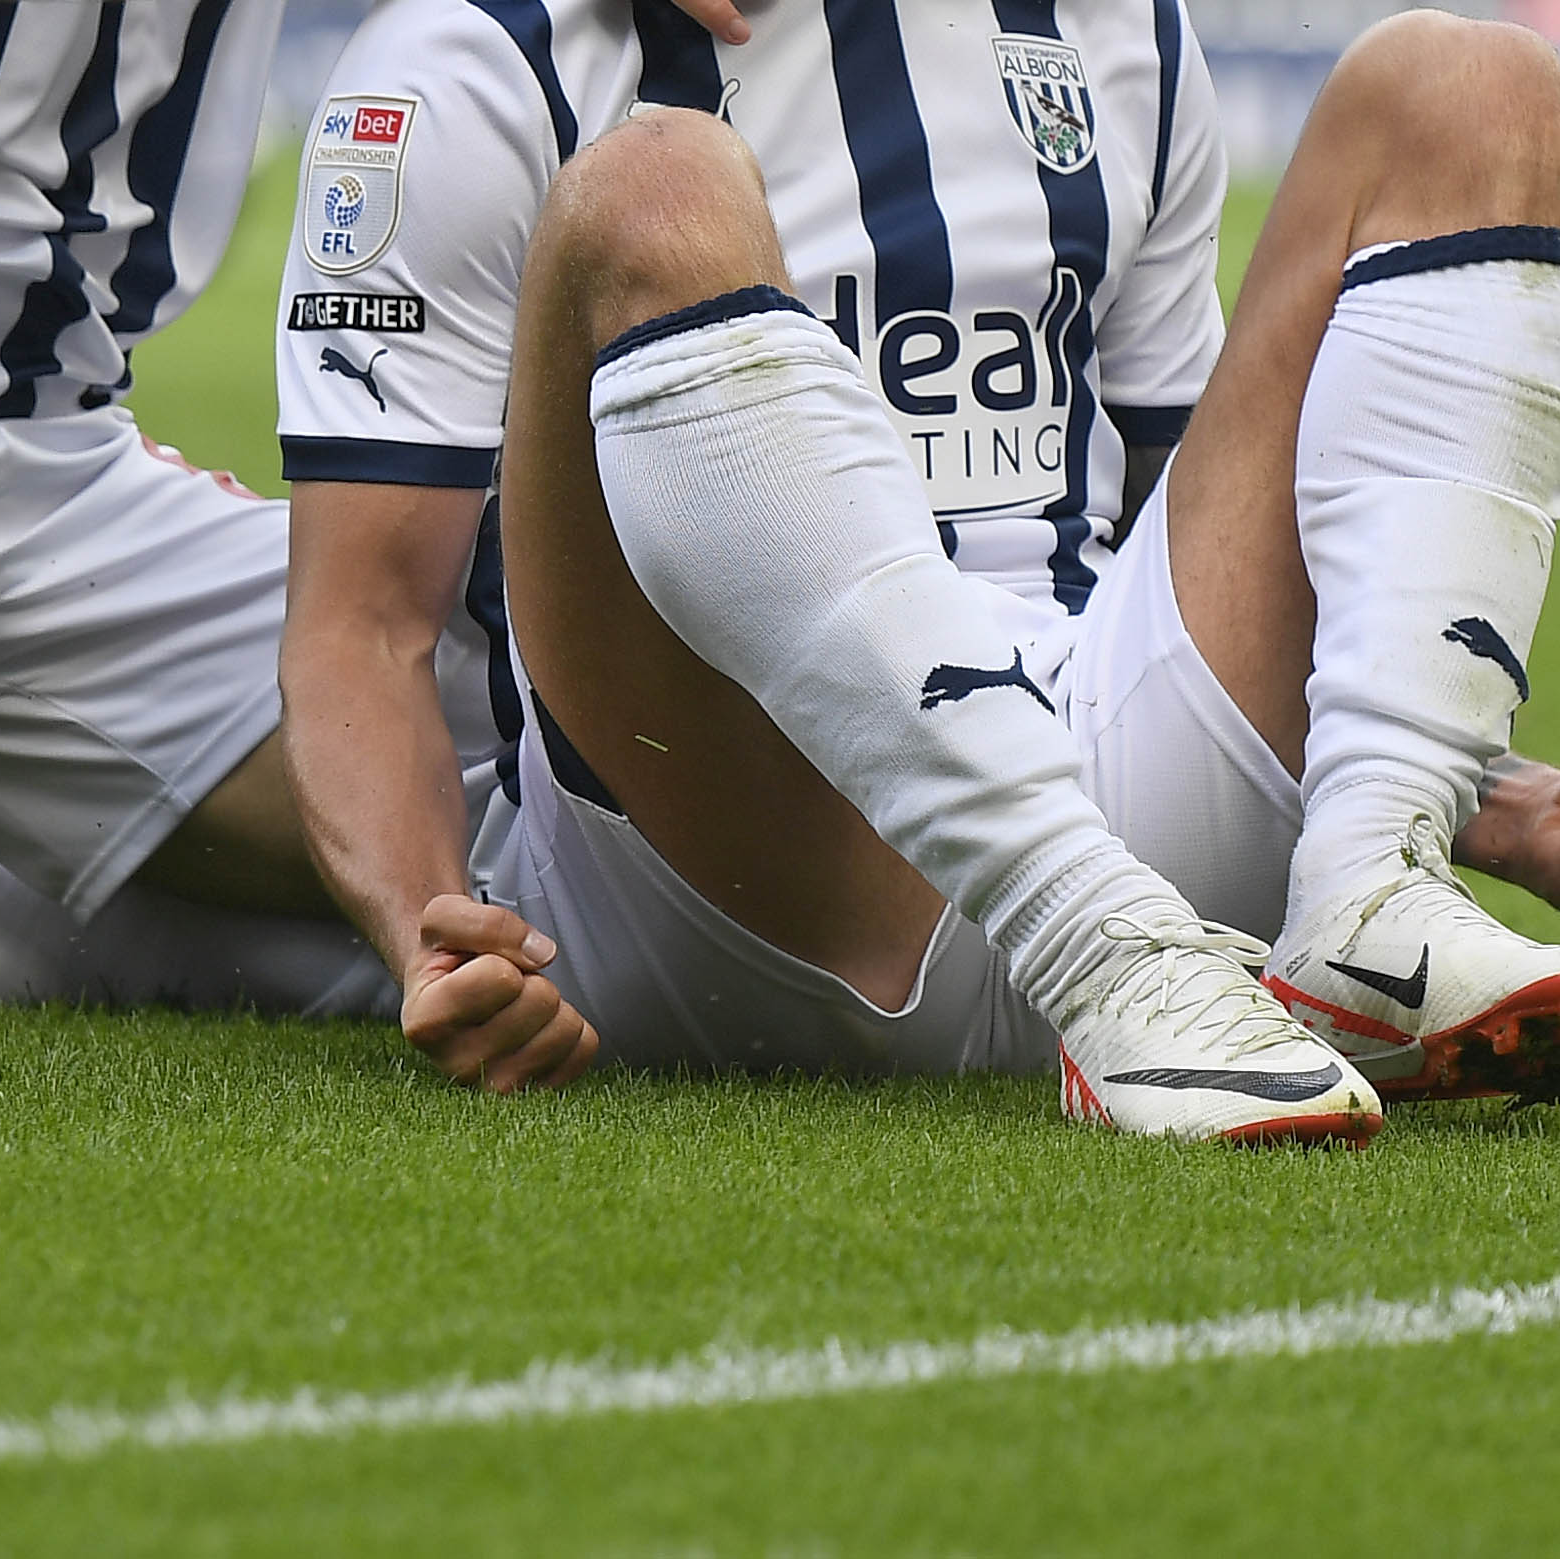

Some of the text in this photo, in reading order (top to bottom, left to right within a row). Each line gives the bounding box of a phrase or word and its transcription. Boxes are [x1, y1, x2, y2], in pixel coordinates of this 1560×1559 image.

[1004, 54, 1079, 82] ALBION
[322, 109, 398, 140] sky bet
[322, 231, 355, 255] EFL
[295, 296, 419, 329] TOGETHER
[816, 272, 1081, 417] deal
[911, 424, 1063, 480] TING
